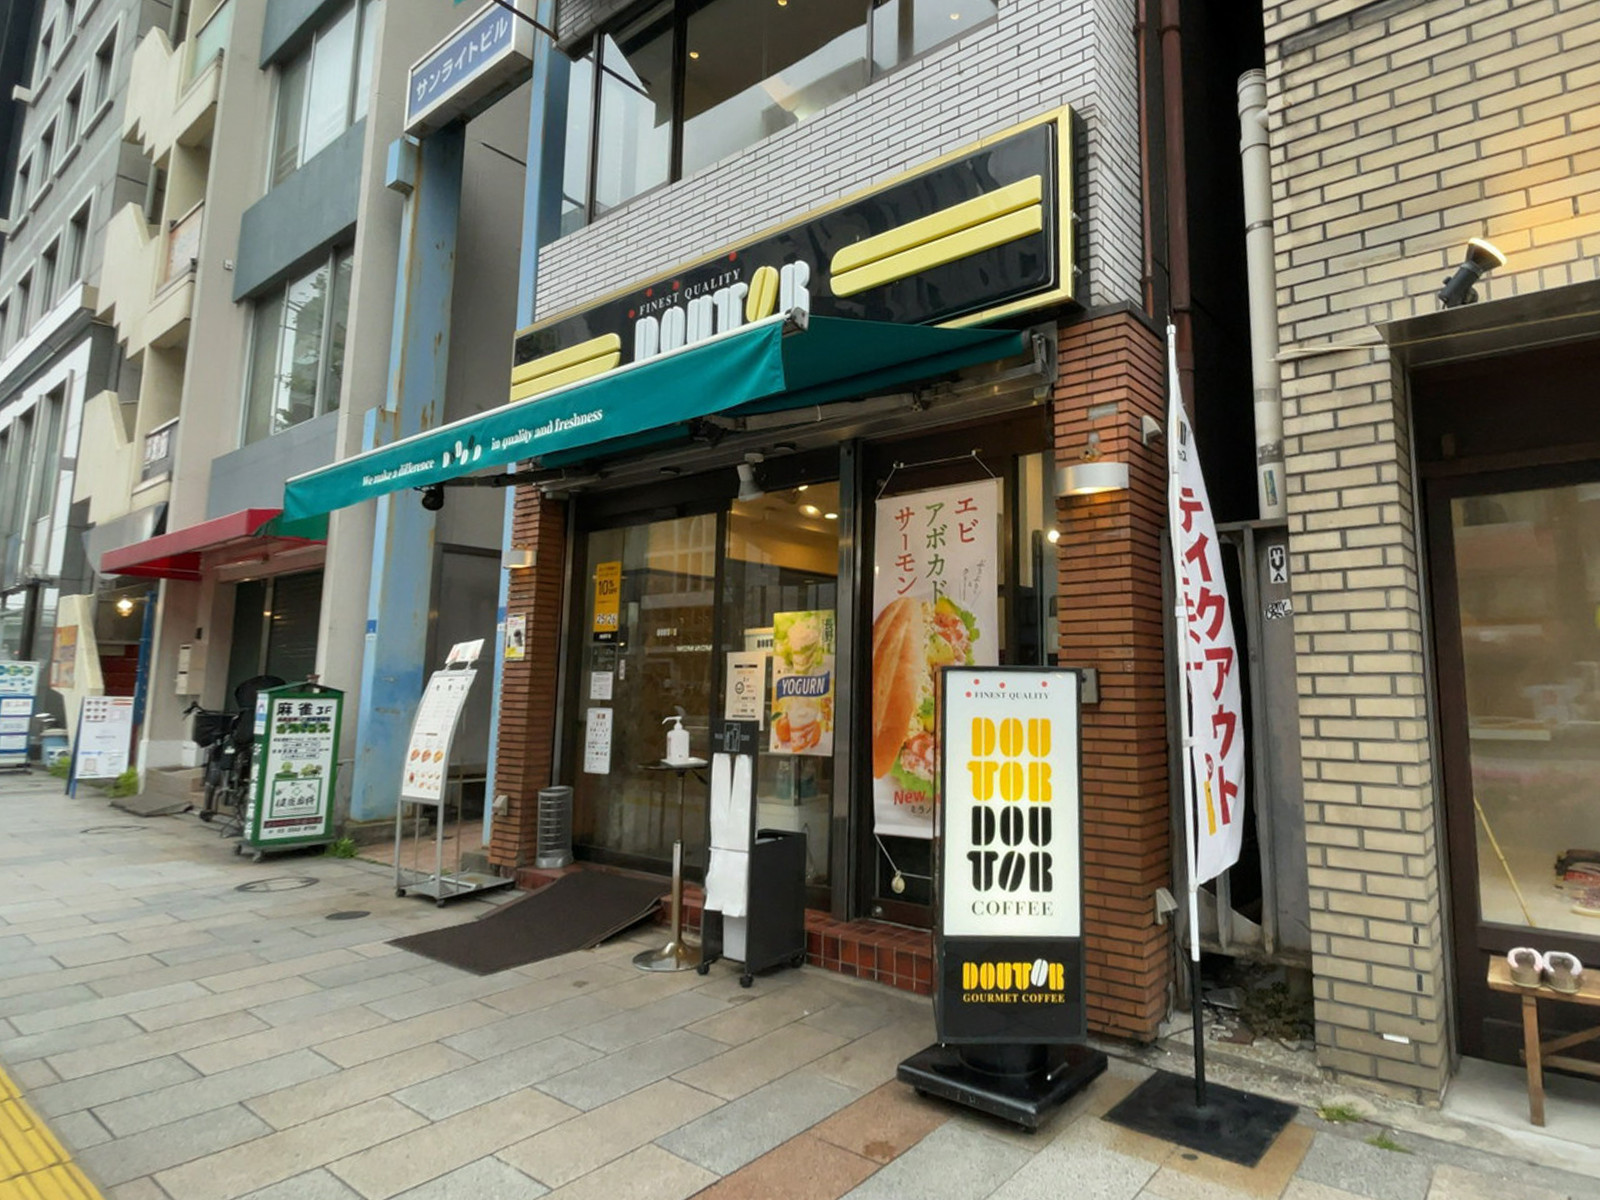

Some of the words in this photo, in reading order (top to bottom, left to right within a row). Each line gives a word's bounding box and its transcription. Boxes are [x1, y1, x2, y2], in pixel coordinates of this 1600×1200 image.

[415, 16, 509, 103] サンライトビル
[639, 292, 680, 316] FINEST
[684, 268, 742, 299] QUALITY
[491, 437, 501, 451] in
[502, 428, 532, 450] quality
[533, 420, 553, 438] and
[554, 409, 603, 433] freshness
[955, 497, 979, 543] エビ
[894, 506, 918, 595] サーモン
[925, 502, 948, 605] アボカド
[781, 676, 827, 696] YOGURN
[974, 691, 1006, 699] FINEST
[1008, 691, 1049, 701] QUALITY
[971, 716, 1053, 758] DOU
[893, 790, 926, 806] New
[966, 760, 1053, 803] TOR
[971, 804, 1053, 848] DOU
[966, 850, 1054, 893] TOR
[971, 900, 1054, 917] COFFEE
[962, 958, 1065, 991] DOUTOR
[962, 993, 1019, 1003] GOURMET
[1021, 993, 1066, 1004] COFFEE
